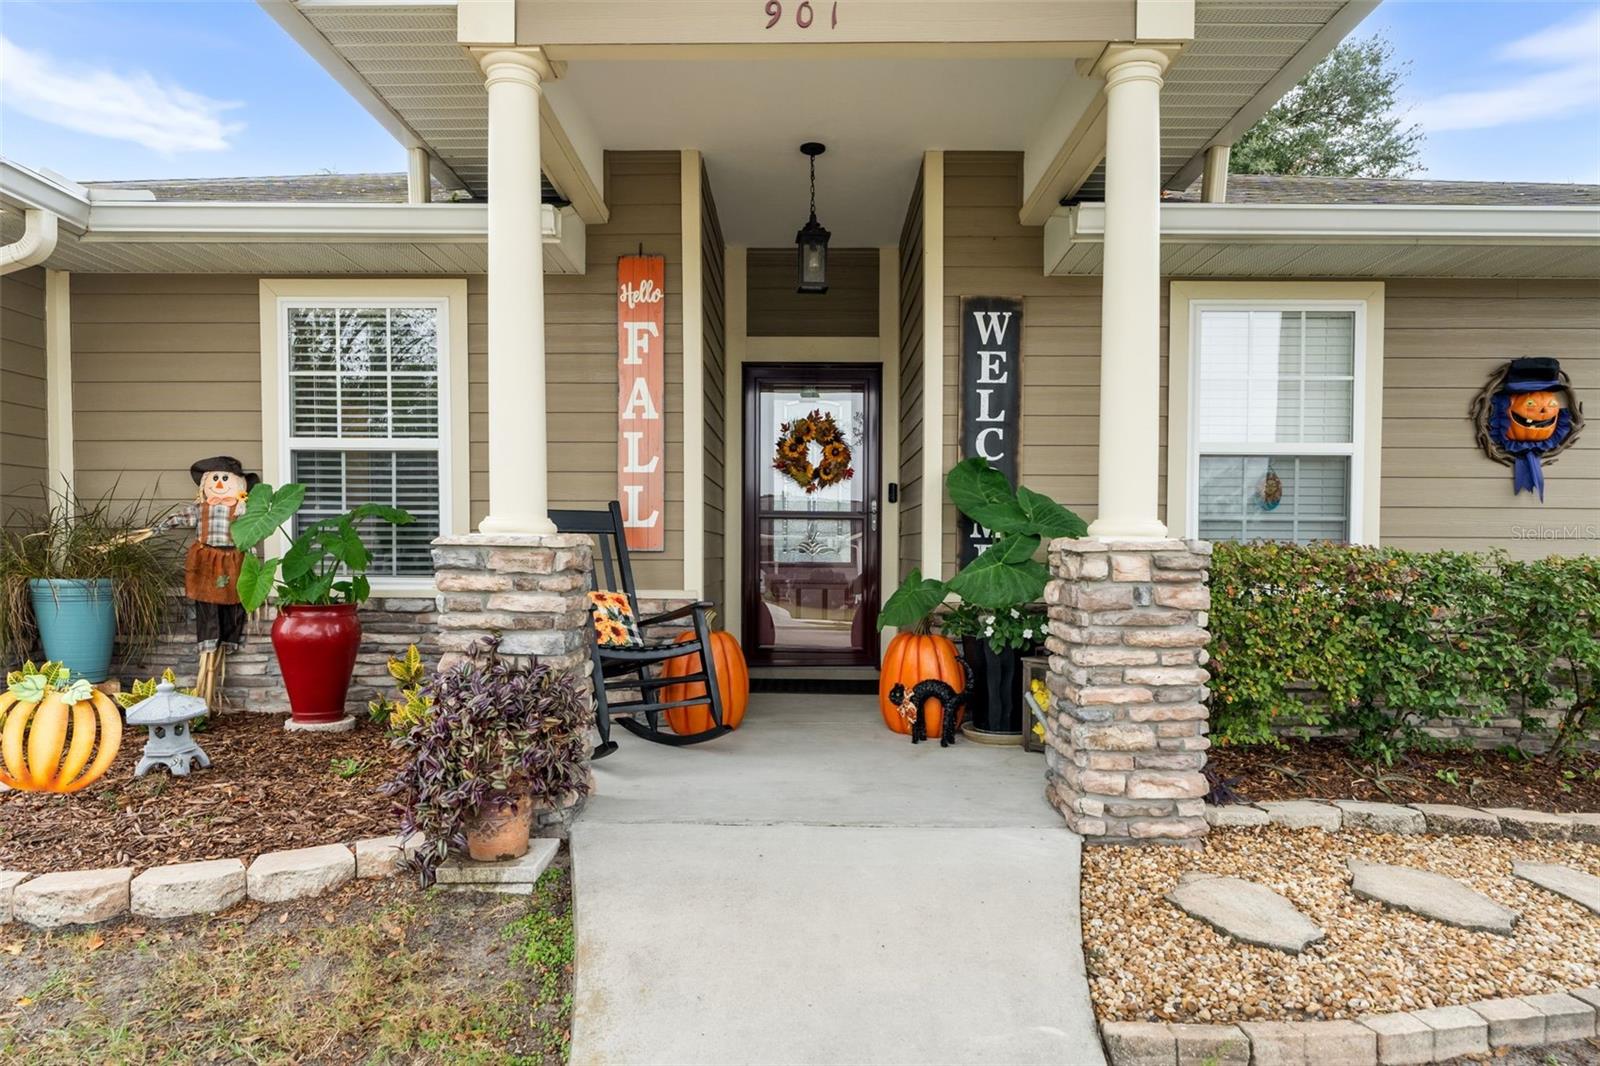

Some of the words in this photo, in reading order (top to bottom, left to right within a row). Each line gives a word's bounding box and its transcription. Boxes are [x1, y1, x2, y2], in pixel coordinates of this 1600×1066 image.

[765, 0, 837, 29] 901
[619, 280, 663, 309] Hello
[622, 321, 659, 528] FALL
[970, 311, 1012, 558] WELC
